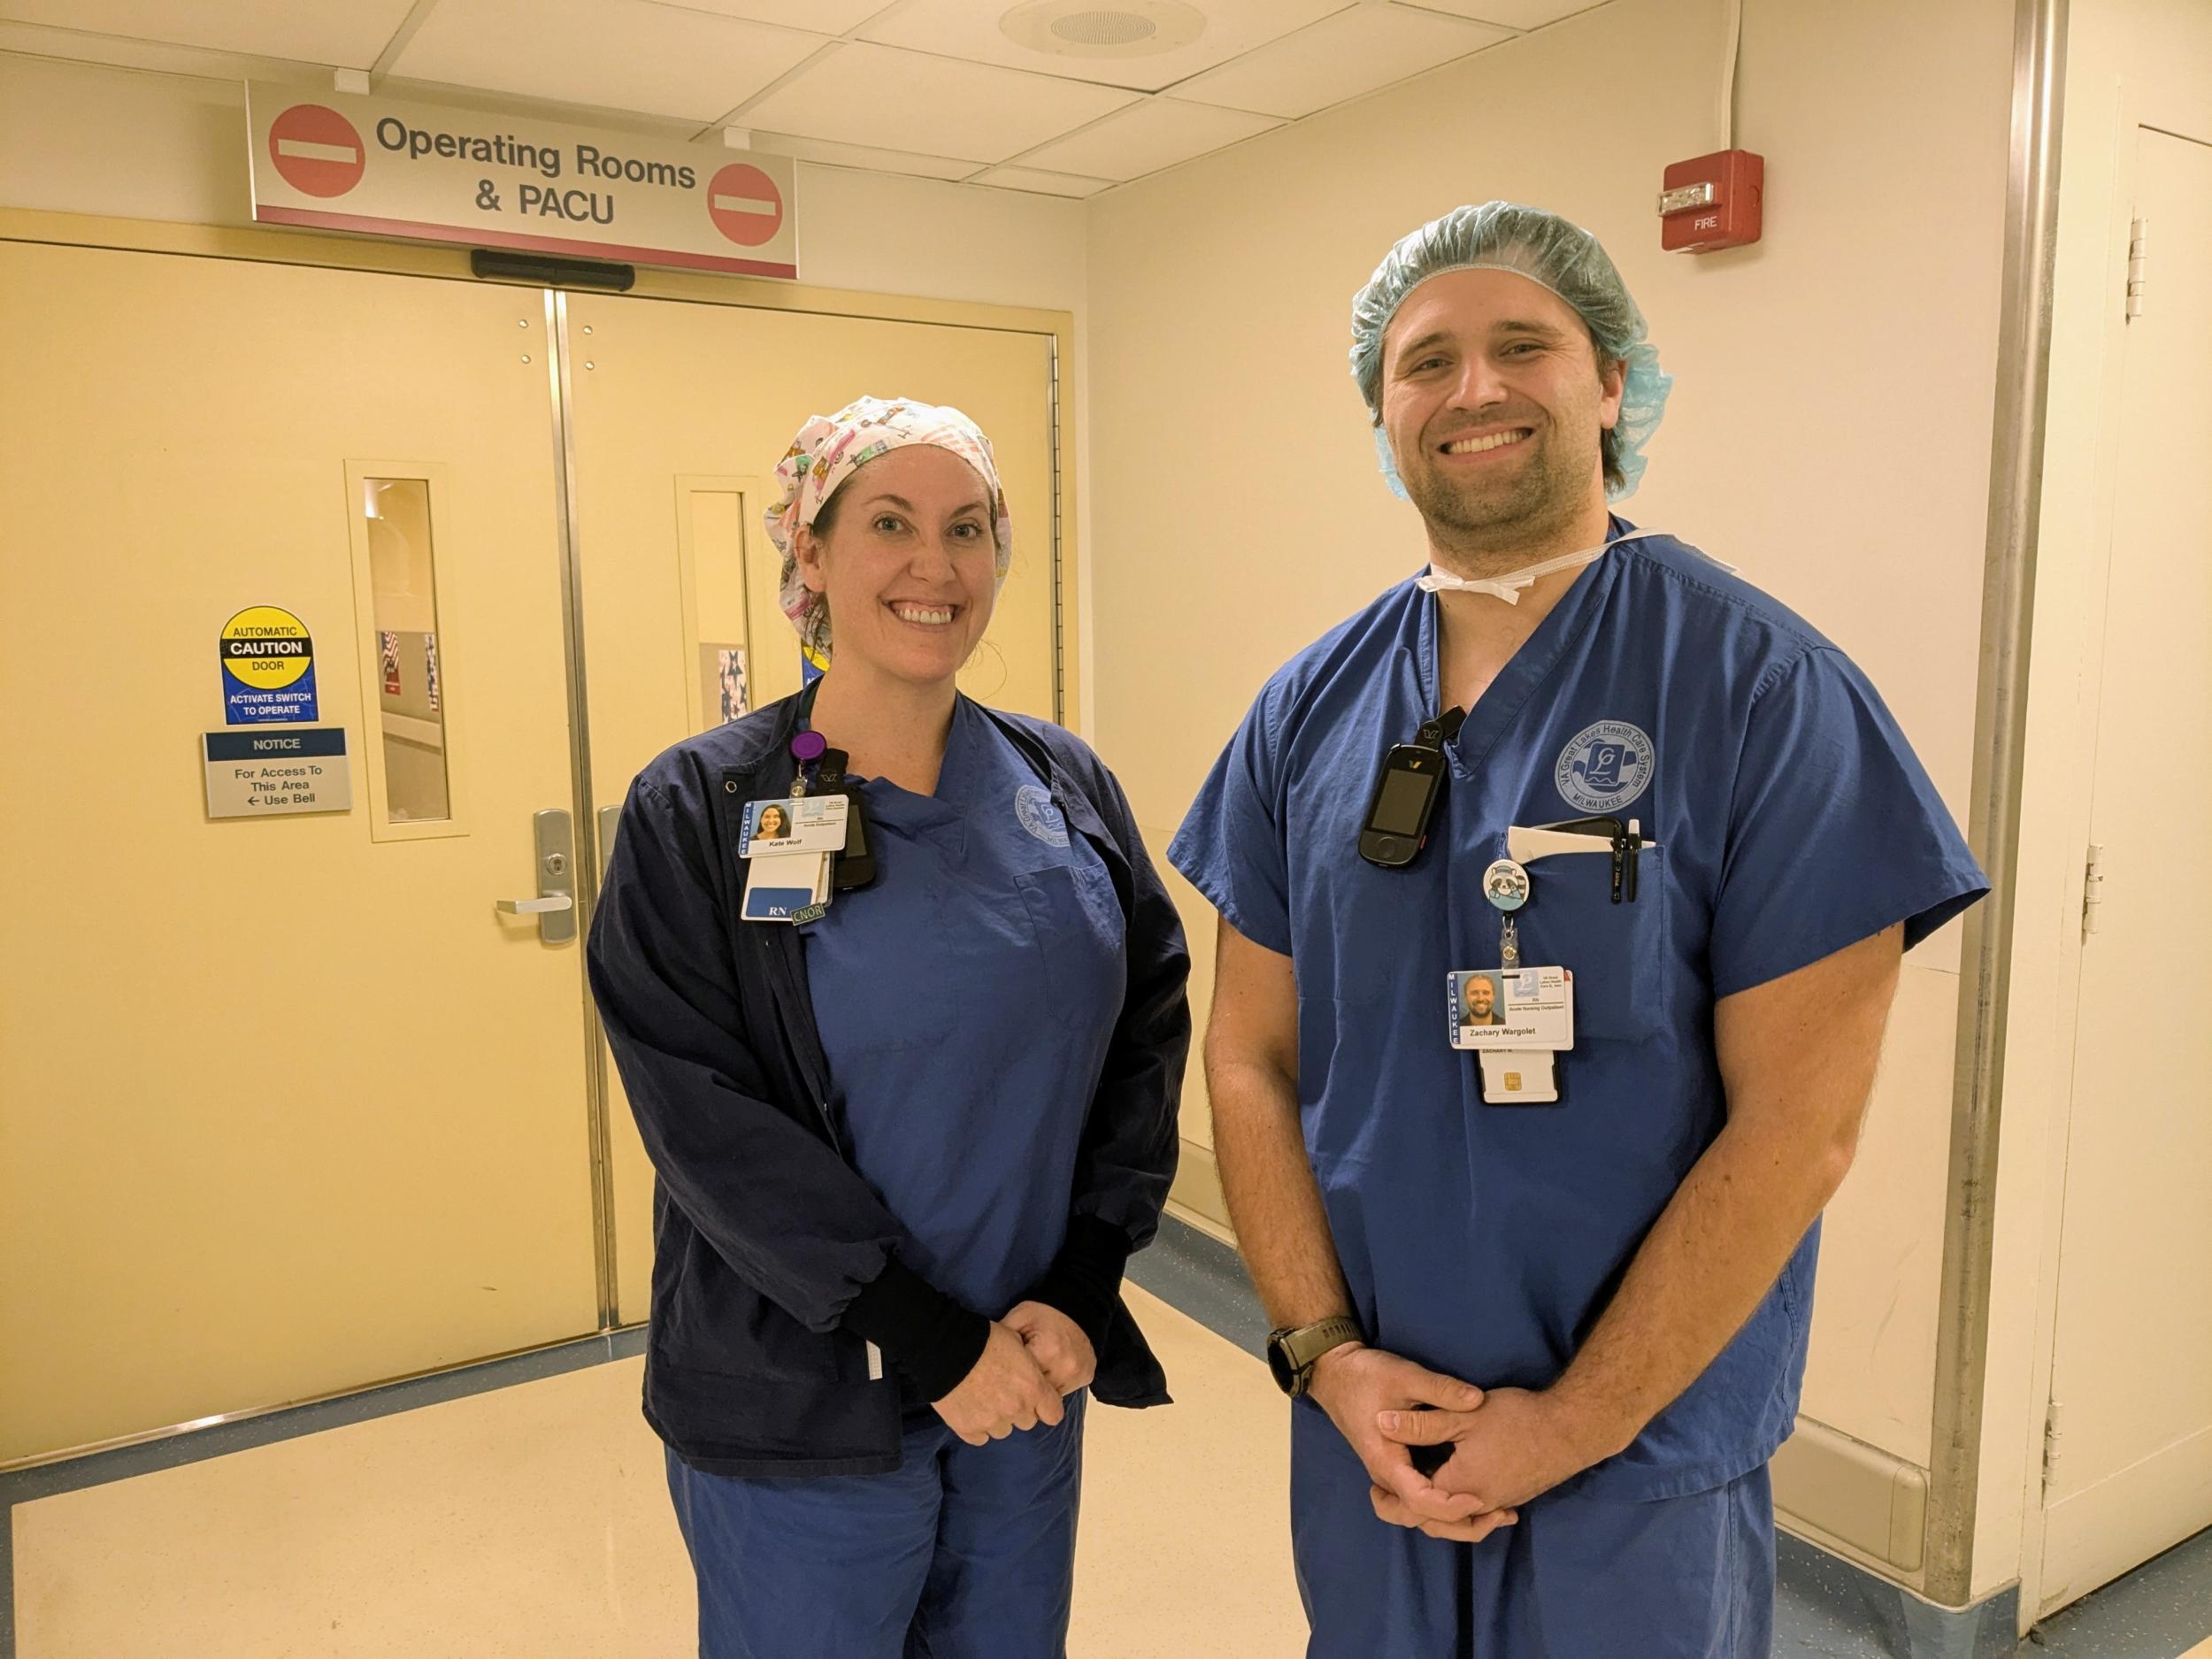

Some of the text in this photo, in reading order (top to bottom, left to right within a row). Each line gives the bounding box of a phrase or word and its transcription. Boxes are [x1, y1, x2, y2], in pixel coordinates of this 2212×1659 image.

[376, 116, 696, 189] Operating Rooms
[475, 180, 613, 225] & PACU
[1694, 216, 1717, 231] FIRE
[233, 626, 297, 637] AUTOMATIC
[230, 641, 303, 655] CAUTION
[252, 661, 284, 671] DOOR
[230, 693, 311, 703] ACTIVATE SWITCH
[258, 705, 300, 715] OPERATE
[253, 738, 301, 750] NOTICE
[1560, 725, 1650, 787] VA Great Lakes Health Care System
[234, 765, 322, 779] For Access To
[250, 780, 310, 792] This Area
[264, 793, 316, 805] Use Bell
[1573, 793, 1623, 808] MILWAUKEE
[741, 803, 751, 854] MILWAUKEE
[769, 907, 787, 916] RN
[793, 905, 823, 923] CNOR
[1448, 973, 1458, 1044] MILWAUKEE
[1502, 1027, 1536, 1036] Wargolet
